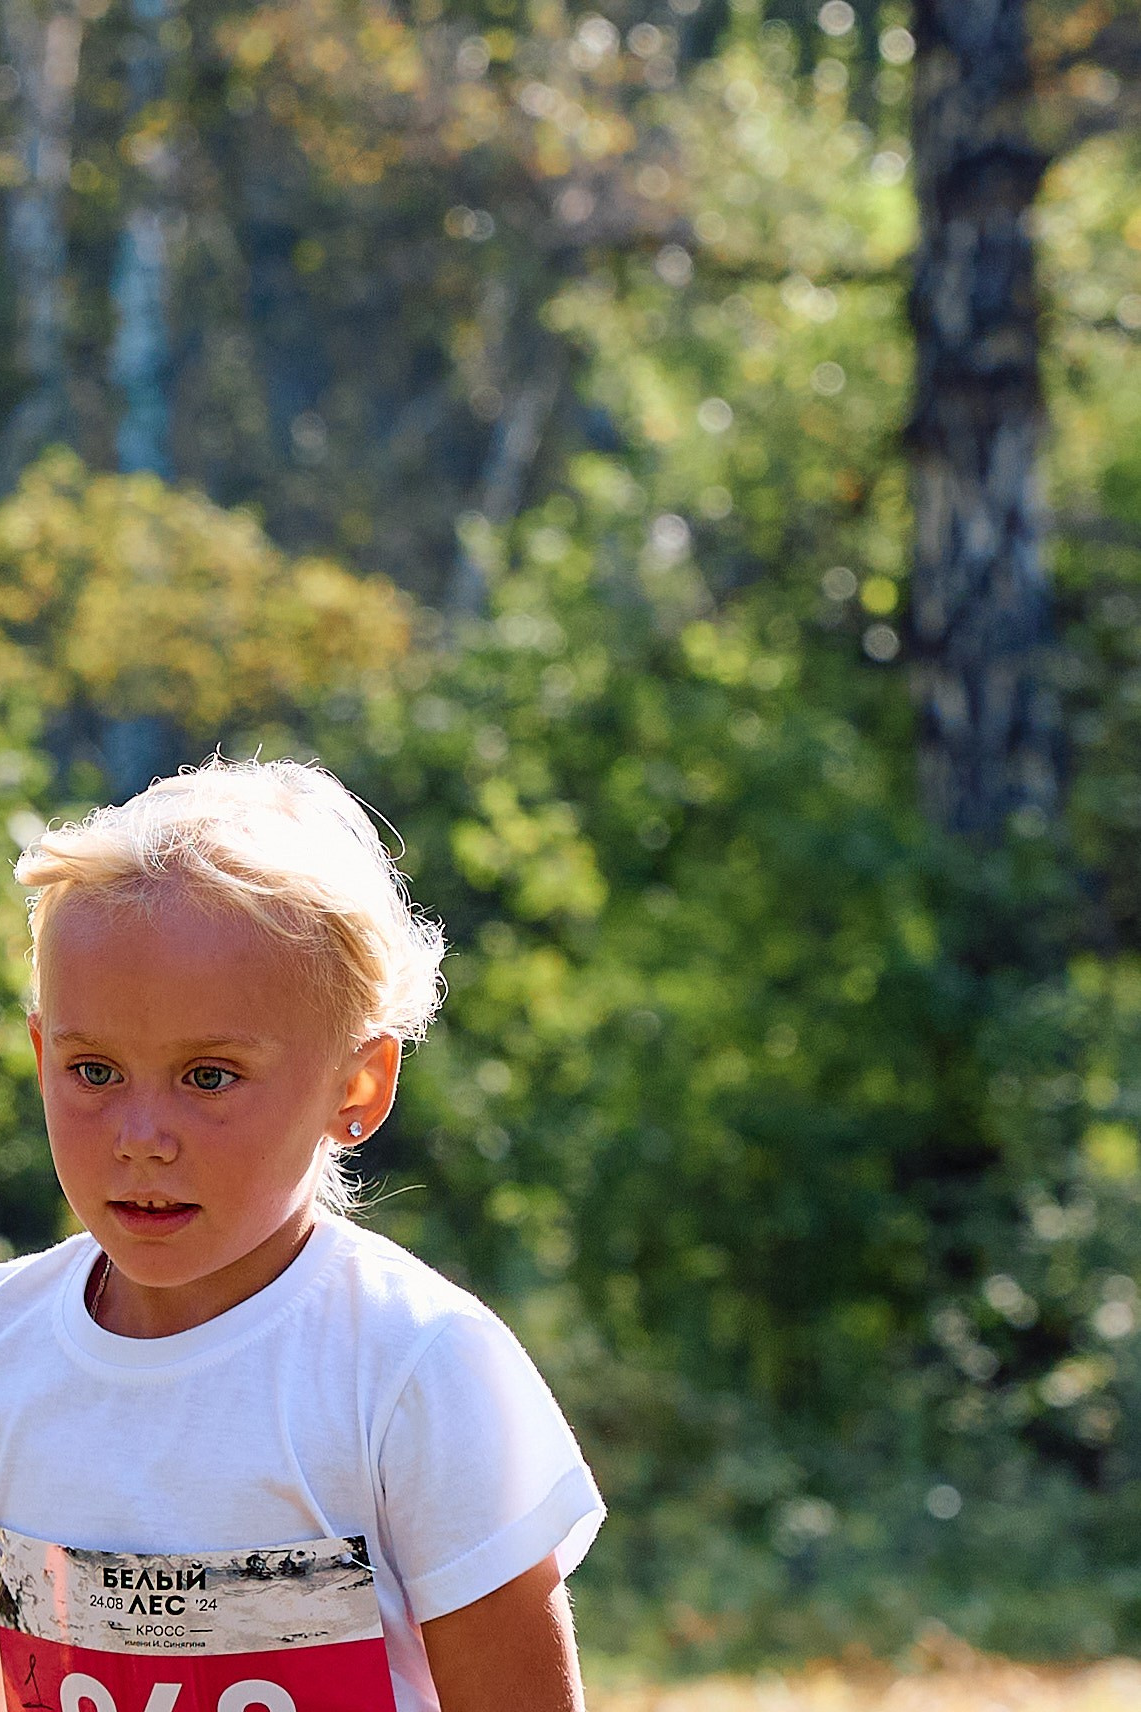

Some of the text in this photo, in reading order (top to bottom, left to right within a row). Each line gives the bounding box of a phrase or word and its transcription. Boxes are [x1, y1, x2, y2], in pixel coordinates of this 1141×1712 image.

[103, 1563, 206, 1591] БЕЛЫЙ
[89, 1594, 218, 1616] 24.08 ЛЕС '24
[136, 1625, 185, 1637] КРОСС
[124, 1640, 151, 1648] имени
